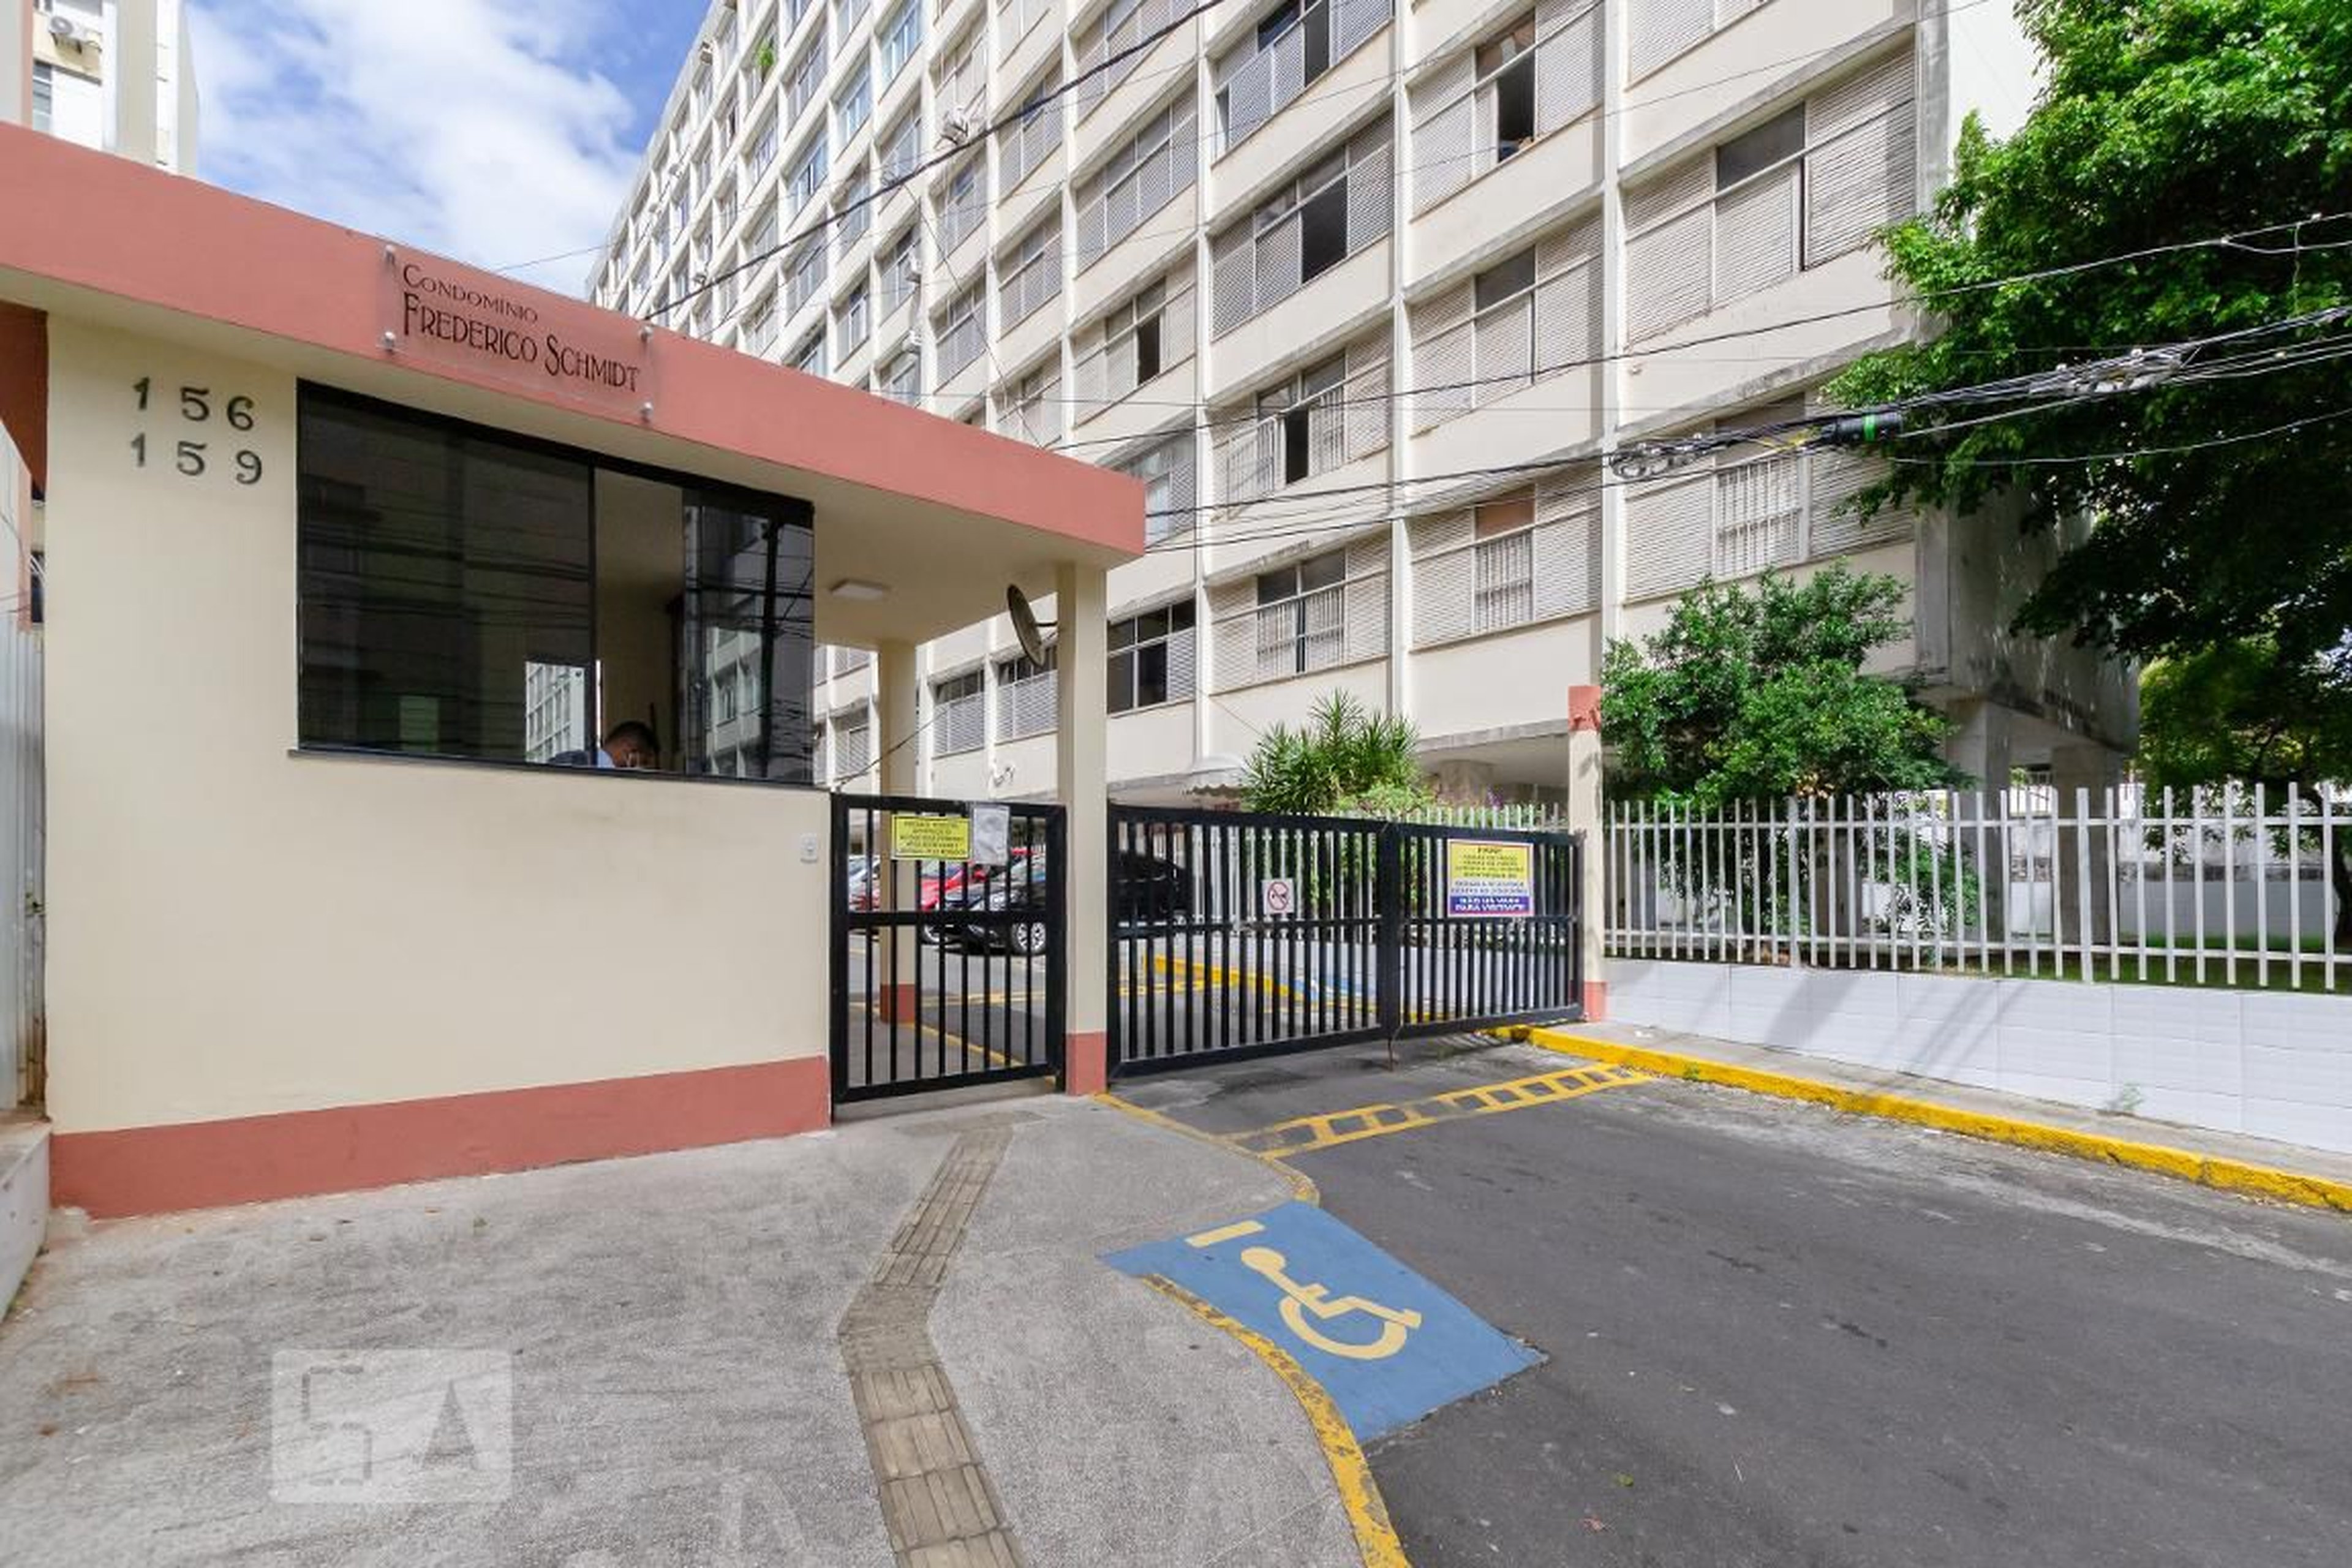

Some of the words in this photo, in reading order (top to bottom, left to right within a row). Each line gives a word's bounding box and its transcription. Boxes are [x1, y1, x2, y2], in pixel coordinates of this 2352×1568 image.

[403, 291, 538, 364] FREDERICO
[545, 334, 641, 392] SCHMIDT
[132, 376, 254, 431] 156
[130, 432, 262, 484] 159
